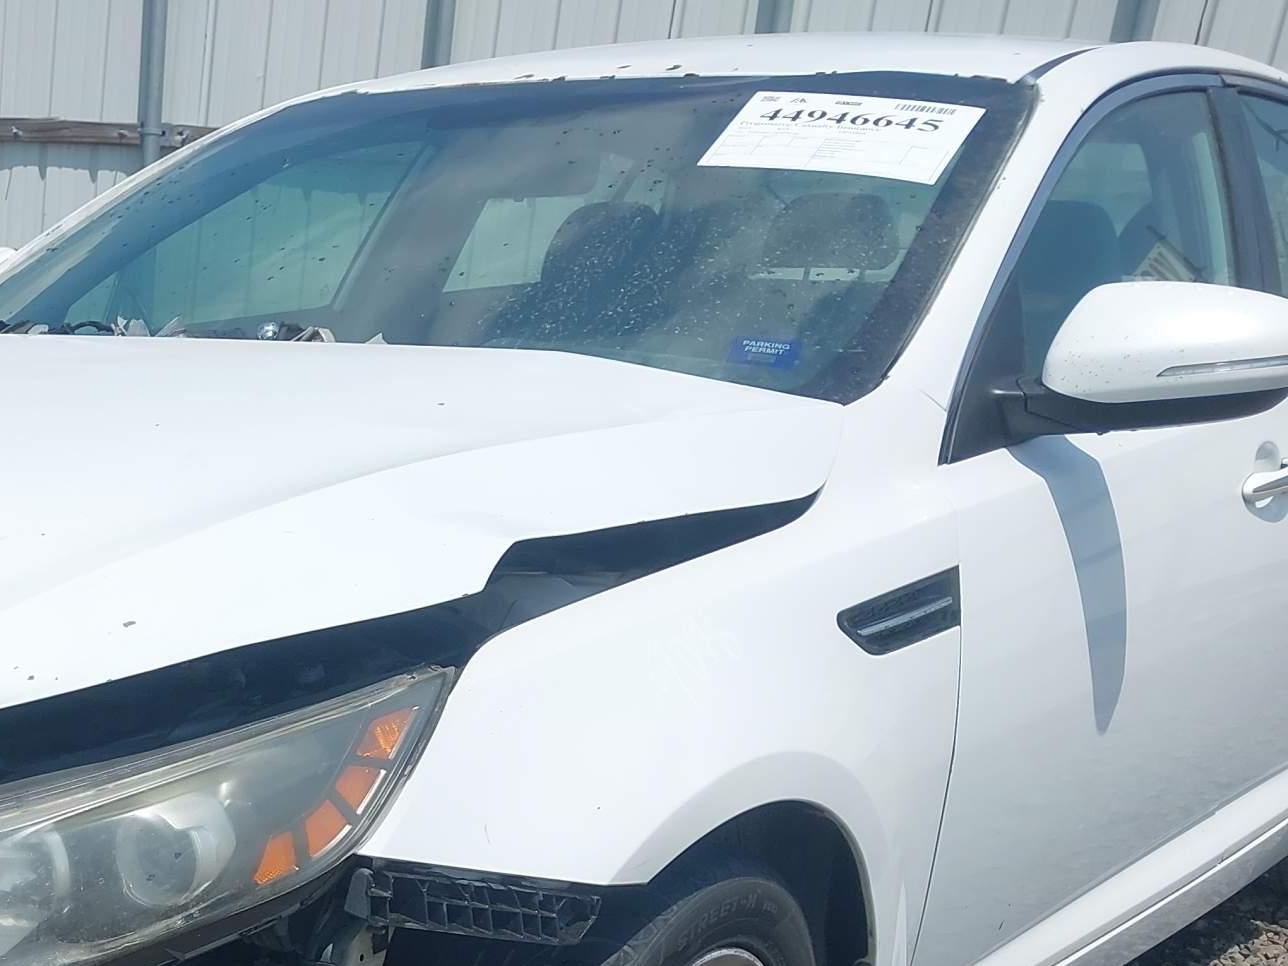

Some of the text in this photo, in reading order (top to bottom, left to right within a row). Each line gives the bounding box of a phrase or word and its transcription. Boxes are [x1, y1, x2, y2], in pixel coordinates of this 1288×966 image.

[759, 107, 945, 132] 44946645
[742, 340, 791, 350] PARKING
[744, 345, 785, 355] PERMIT
